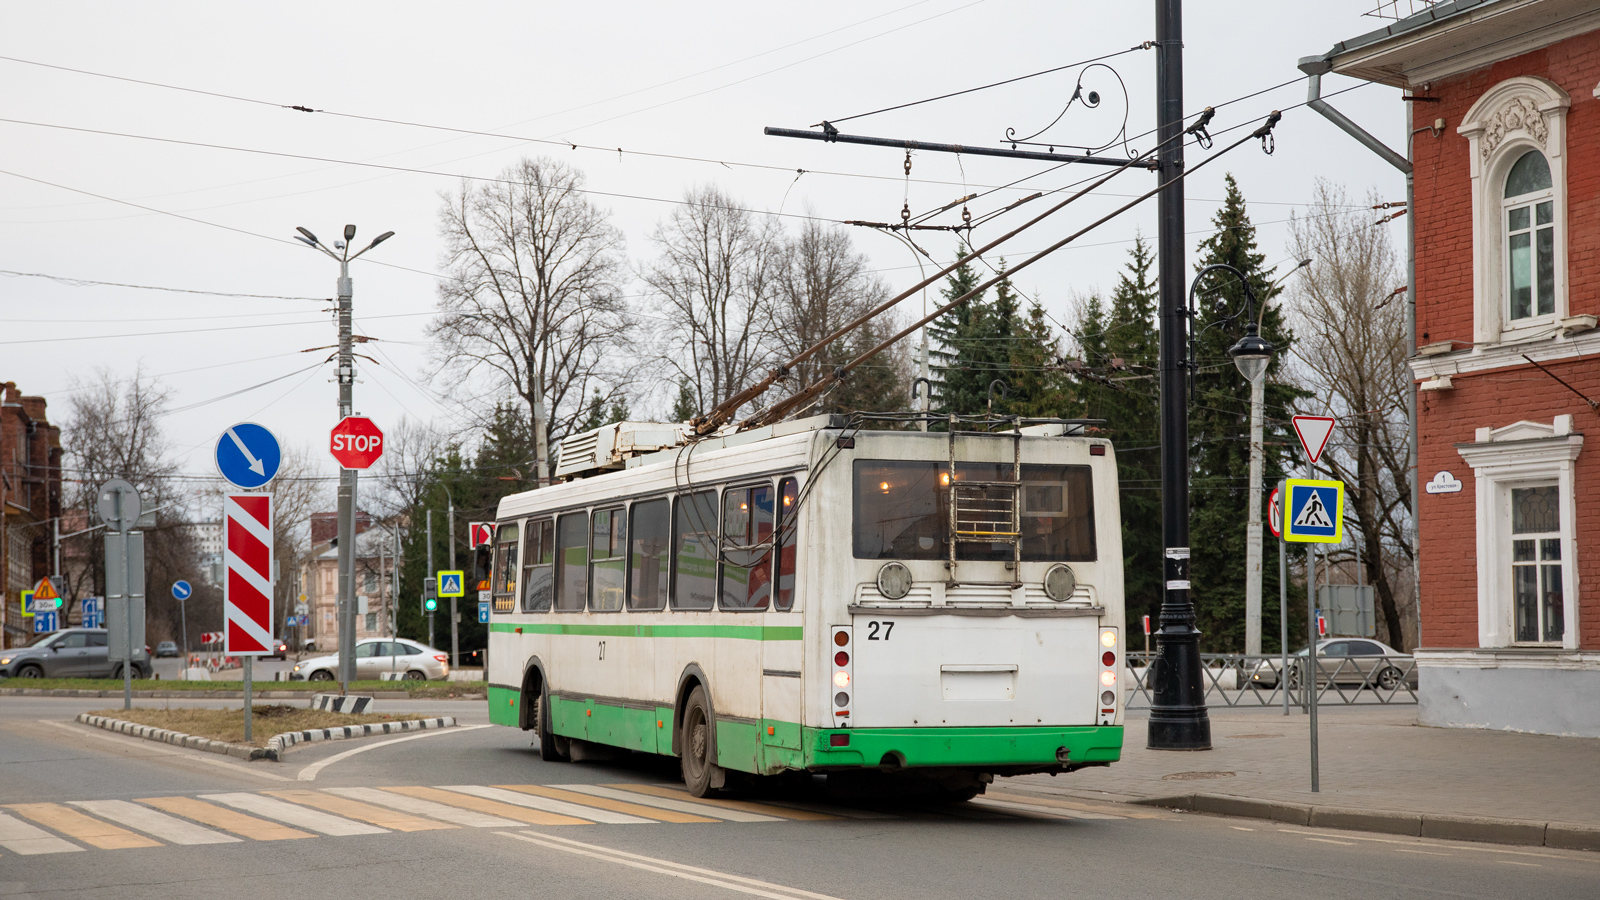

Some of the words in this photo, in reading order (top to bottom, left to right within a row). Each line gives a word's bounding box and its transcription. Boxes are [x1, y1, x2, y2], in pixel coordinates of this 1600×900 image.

[332, 434, 381, 452] STOP
[1442, 474, 1446, 483] 1
[867, 621, 895, 641] 27
[598, 641, 606, 661] 27
